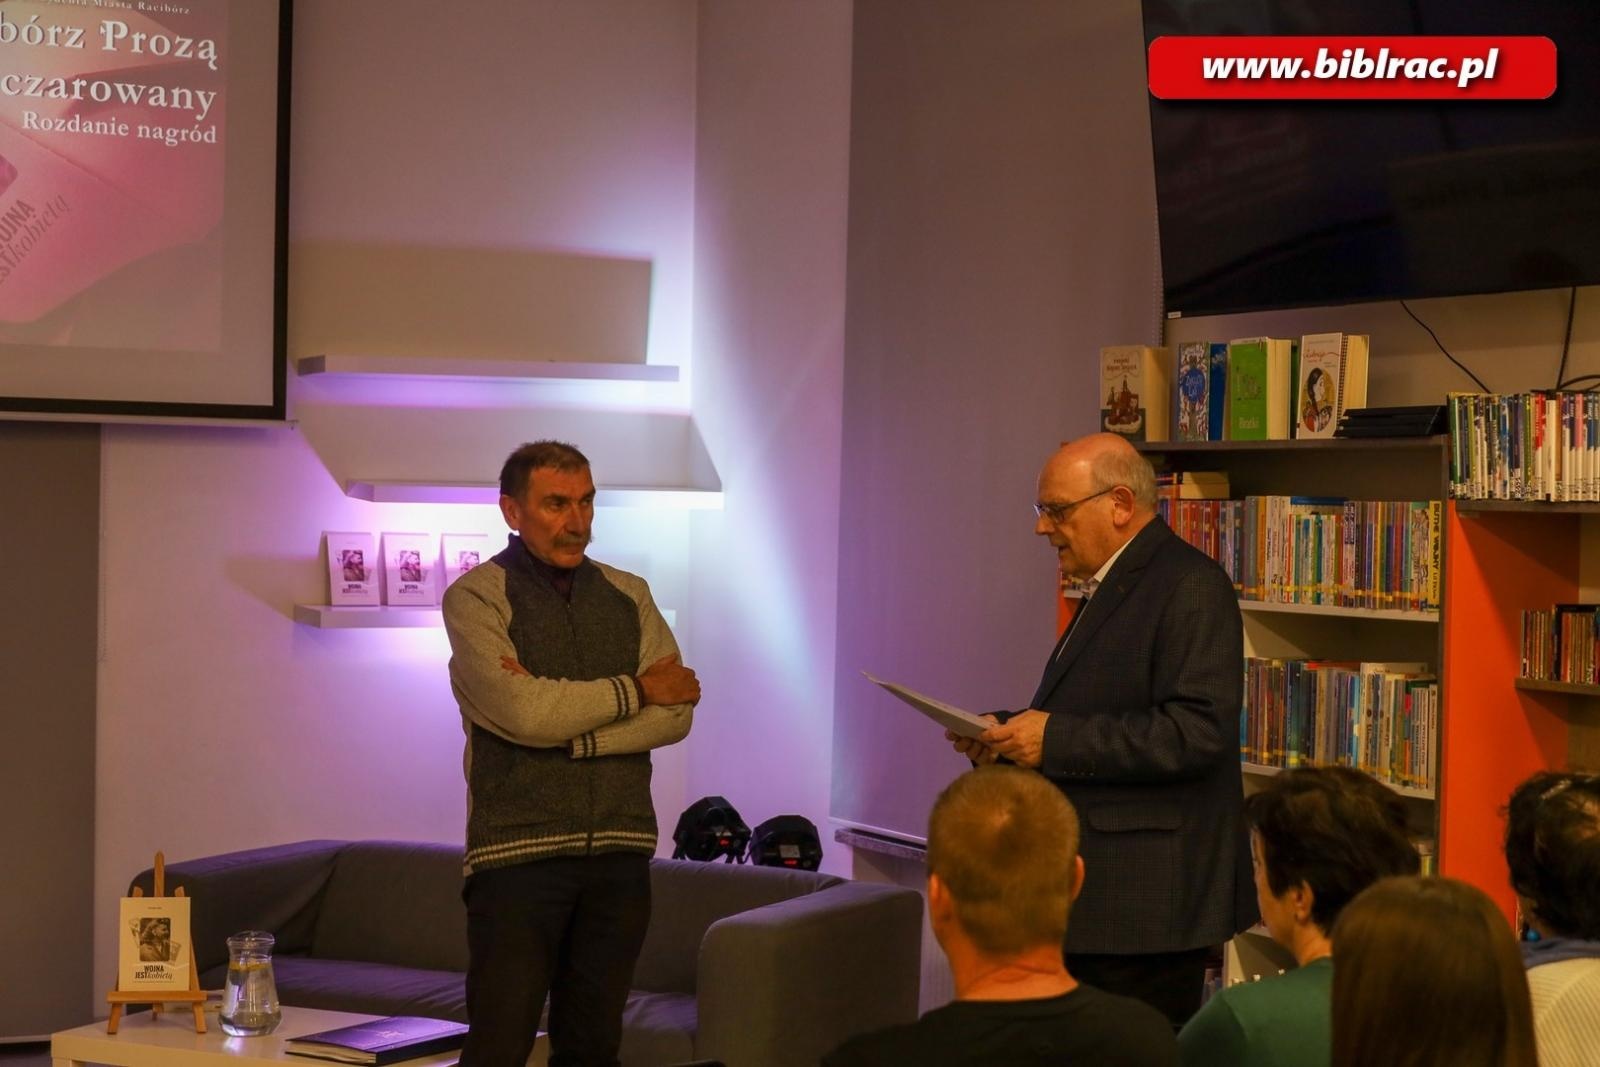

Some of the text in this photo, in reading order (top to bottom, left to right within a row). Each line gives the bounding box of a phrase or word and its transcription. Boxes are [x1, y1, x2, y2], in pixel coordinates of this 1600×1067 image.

[138, 2, 190, 14] Racibórz
[0, 11, 218, 70] bórz Prozą
[1, 74, 216, 120] czarowany
[22, 111, 217, 146] Rozdanie nagród
[144, 965, 164, 973] WOJNA
